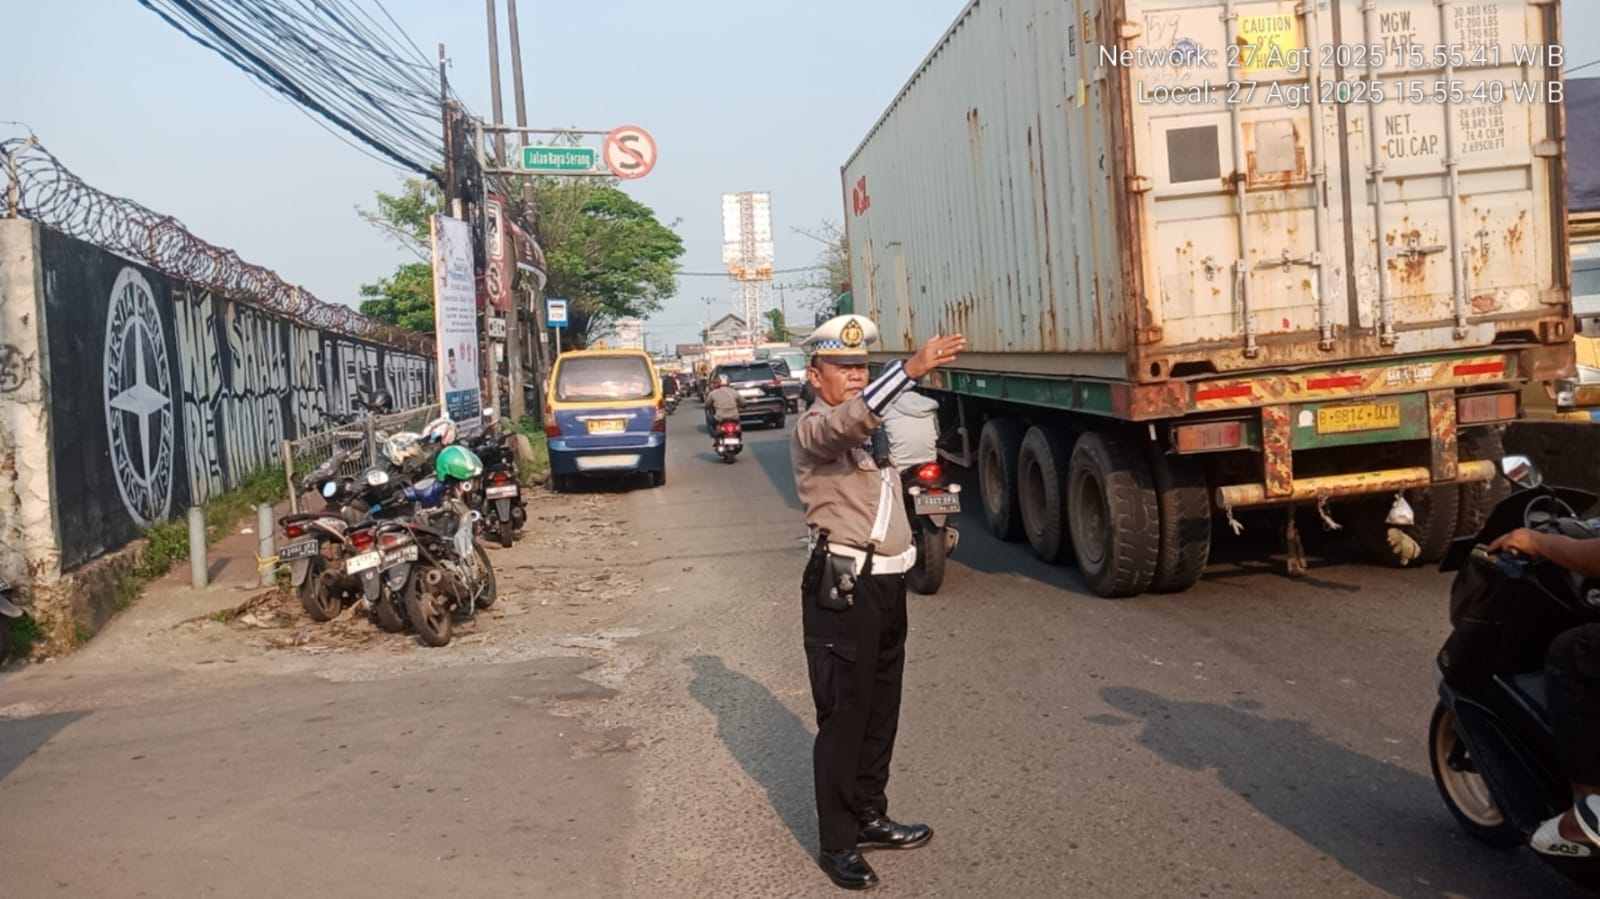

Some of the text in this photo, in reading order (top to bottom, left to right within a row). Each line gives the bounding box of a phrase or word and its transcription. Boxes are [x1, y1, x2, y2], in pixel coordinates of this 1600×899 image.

[1483, 4, 1498, 15] KGS
[1242, 16, 1292, 34] CAUTION
[1380, 10, 1416, 33] MGW.
[1483, 15, 1498, 27] LBS
[1484, 27, 1499, 38] KGS
[1384, 113, 1417, 136] NET.
[1387, 134, 1439, 159] CU.CAP.
[529, 151, 591, 169] Jalan Raya Serang
[174, 289, 222, 401] WE
[226, 301, 289, 399] SHALL
[290, 323, 321, 392] NOT
[184, 398, 224, 502] BE
[222, 394, 285, 489] MOVED
